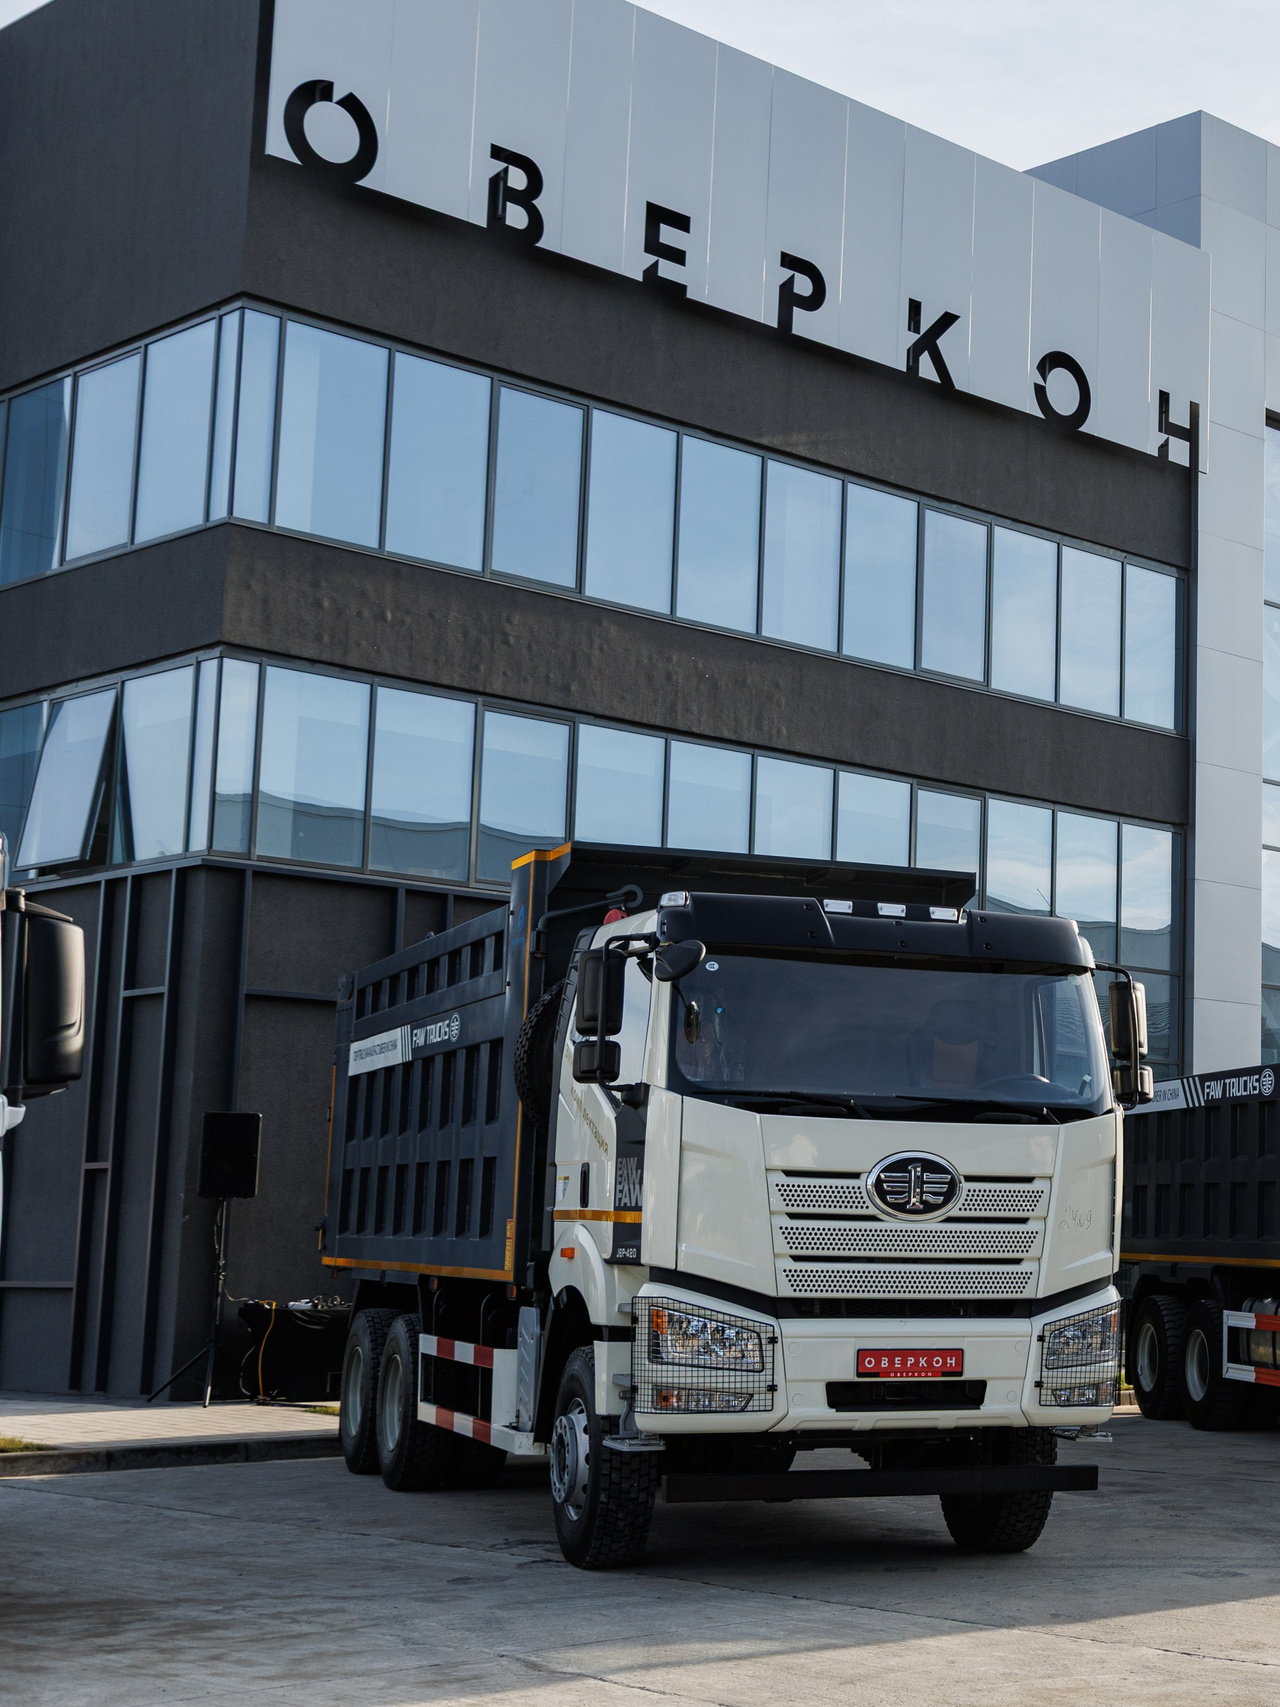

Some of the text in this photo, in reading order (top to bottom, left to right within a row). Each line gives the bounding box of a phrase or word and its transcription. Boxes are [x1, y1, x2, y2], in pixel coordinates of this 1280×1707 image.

[284, 80, 1199, 471] ОВЕРКОН
[412, 1020, 450, 1048] FAW TRUCKS
[1204, 1075, 1259, 1100] FAW TRUCKS
[615, 1184, 643, 1207] FAW
[864, 1356, 956, 1368] ОВЕРКОН
